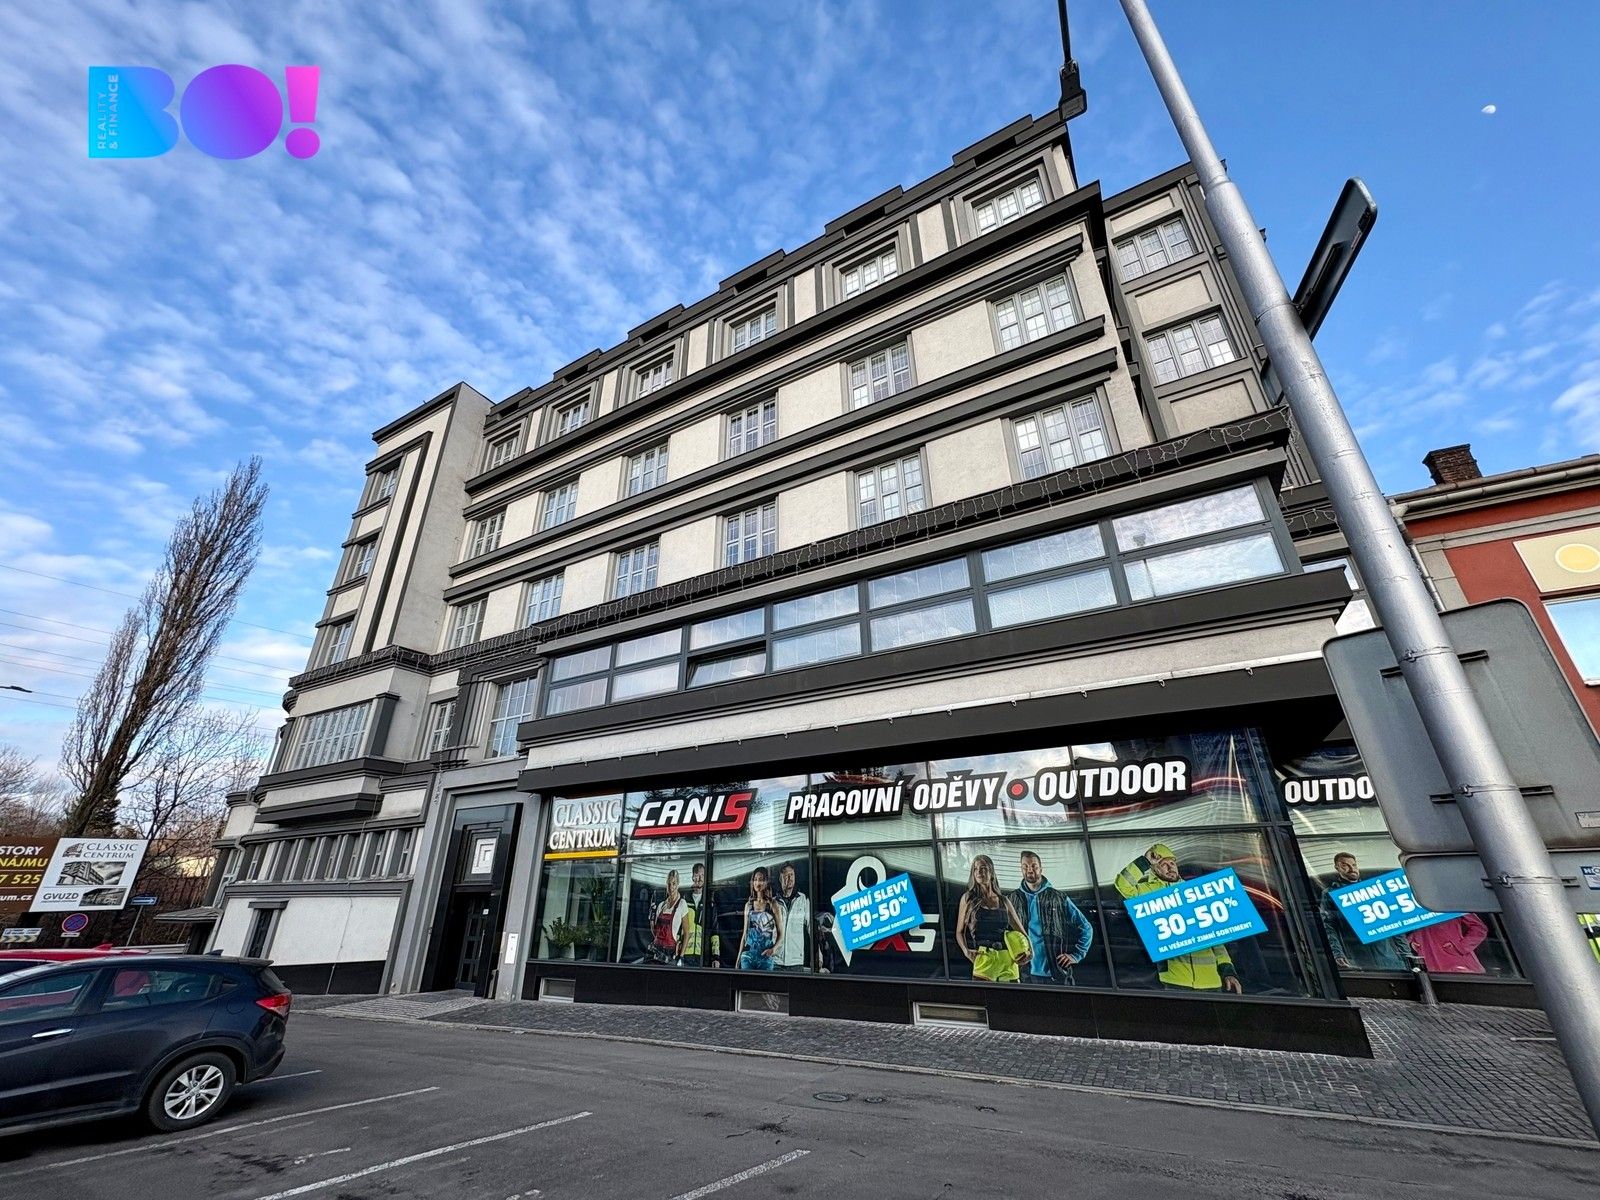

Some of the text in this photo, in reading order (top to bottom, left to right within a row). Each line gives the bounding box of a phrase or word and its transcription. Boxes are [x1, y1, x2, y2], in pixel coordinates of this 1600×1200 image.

[787, 760, 1187, 820] PRACOVNÍ ODĚVY OUTDOOR
[553, 799, 622, 827] CLASSIC
[633, 792, 753, 836] CANIS
[86, 843, 138, 851] CLASSIC
[549, 827, 617, 850] CENTRUM
[11, 874, 42, 885] 525
[1339, 879, 1386, 908] ZIMNÍ
[43, 892, 79, 900] GVUZD
[839, 879, 909, 916] ZIMNÍ SLEVY
[1133, 875, 1236, 919] ZIMNÍ SLEVY
[1358, 892, 1423, 924] 30-5
[850, 895, 908, 932] 30-50%
[1153, 896, 1239, 941] 30-50%
[1158, 944, 1169, 953] NA
[1197, 930, 1216, 943] ZIMNÍ
[1215, 921, 1252, 937] SORTIMENT
